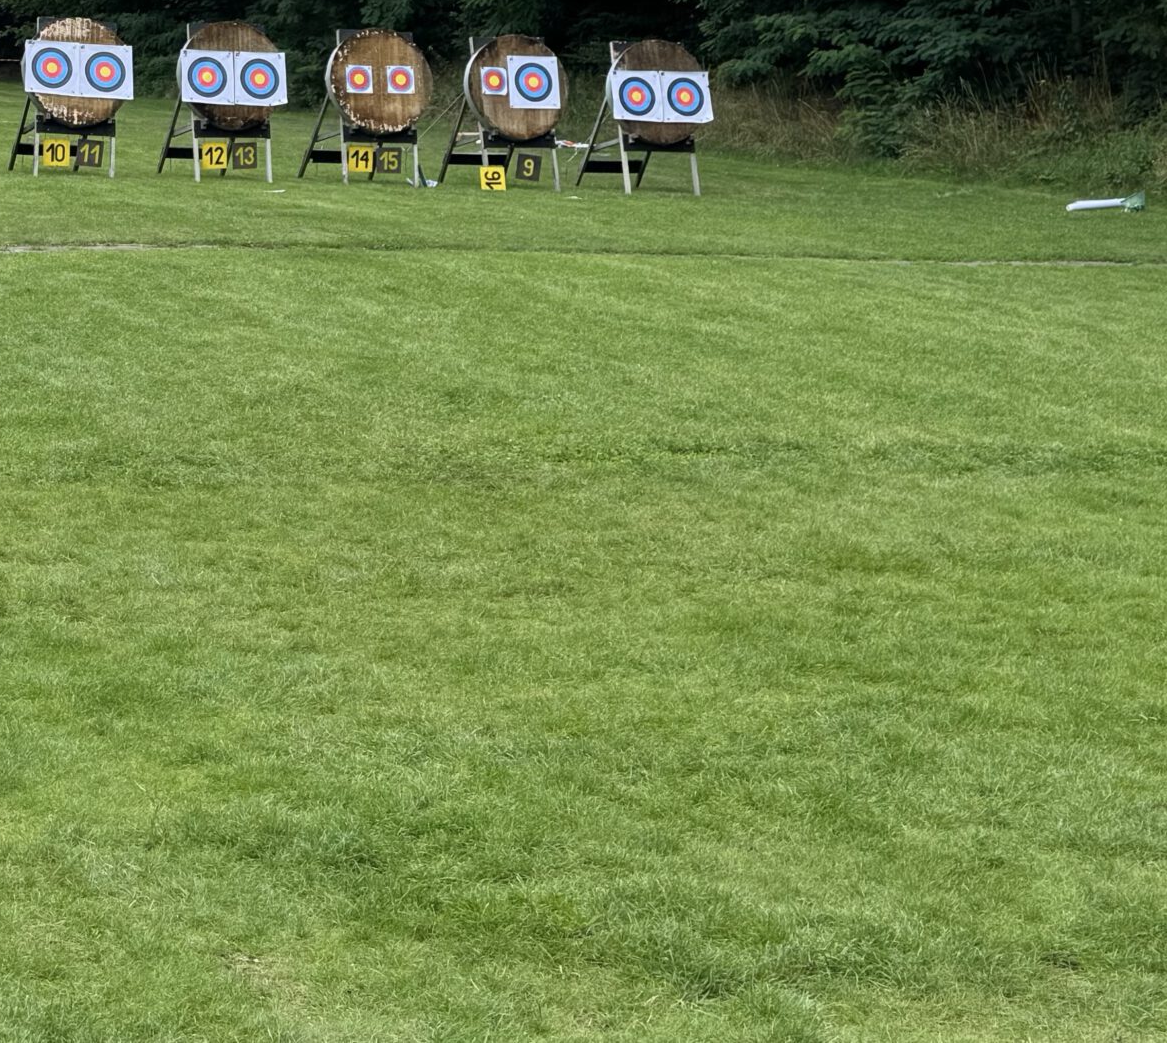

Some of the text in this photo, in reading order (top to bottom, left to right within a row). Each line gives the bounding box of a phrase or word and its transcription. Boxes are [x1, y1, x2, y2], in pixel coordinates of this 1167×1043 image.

[45, 143, 66, 163] 10
[79, 143, 101, 165] 11
[204, 146, 225, 166] 12
[235, 146, 255, 166] 13
[351, 150, 370, 169] 14
[379, 151, 399, 171] 15
[523, 158, 535, 177] 9
[484, 170, 502, 190] 16
